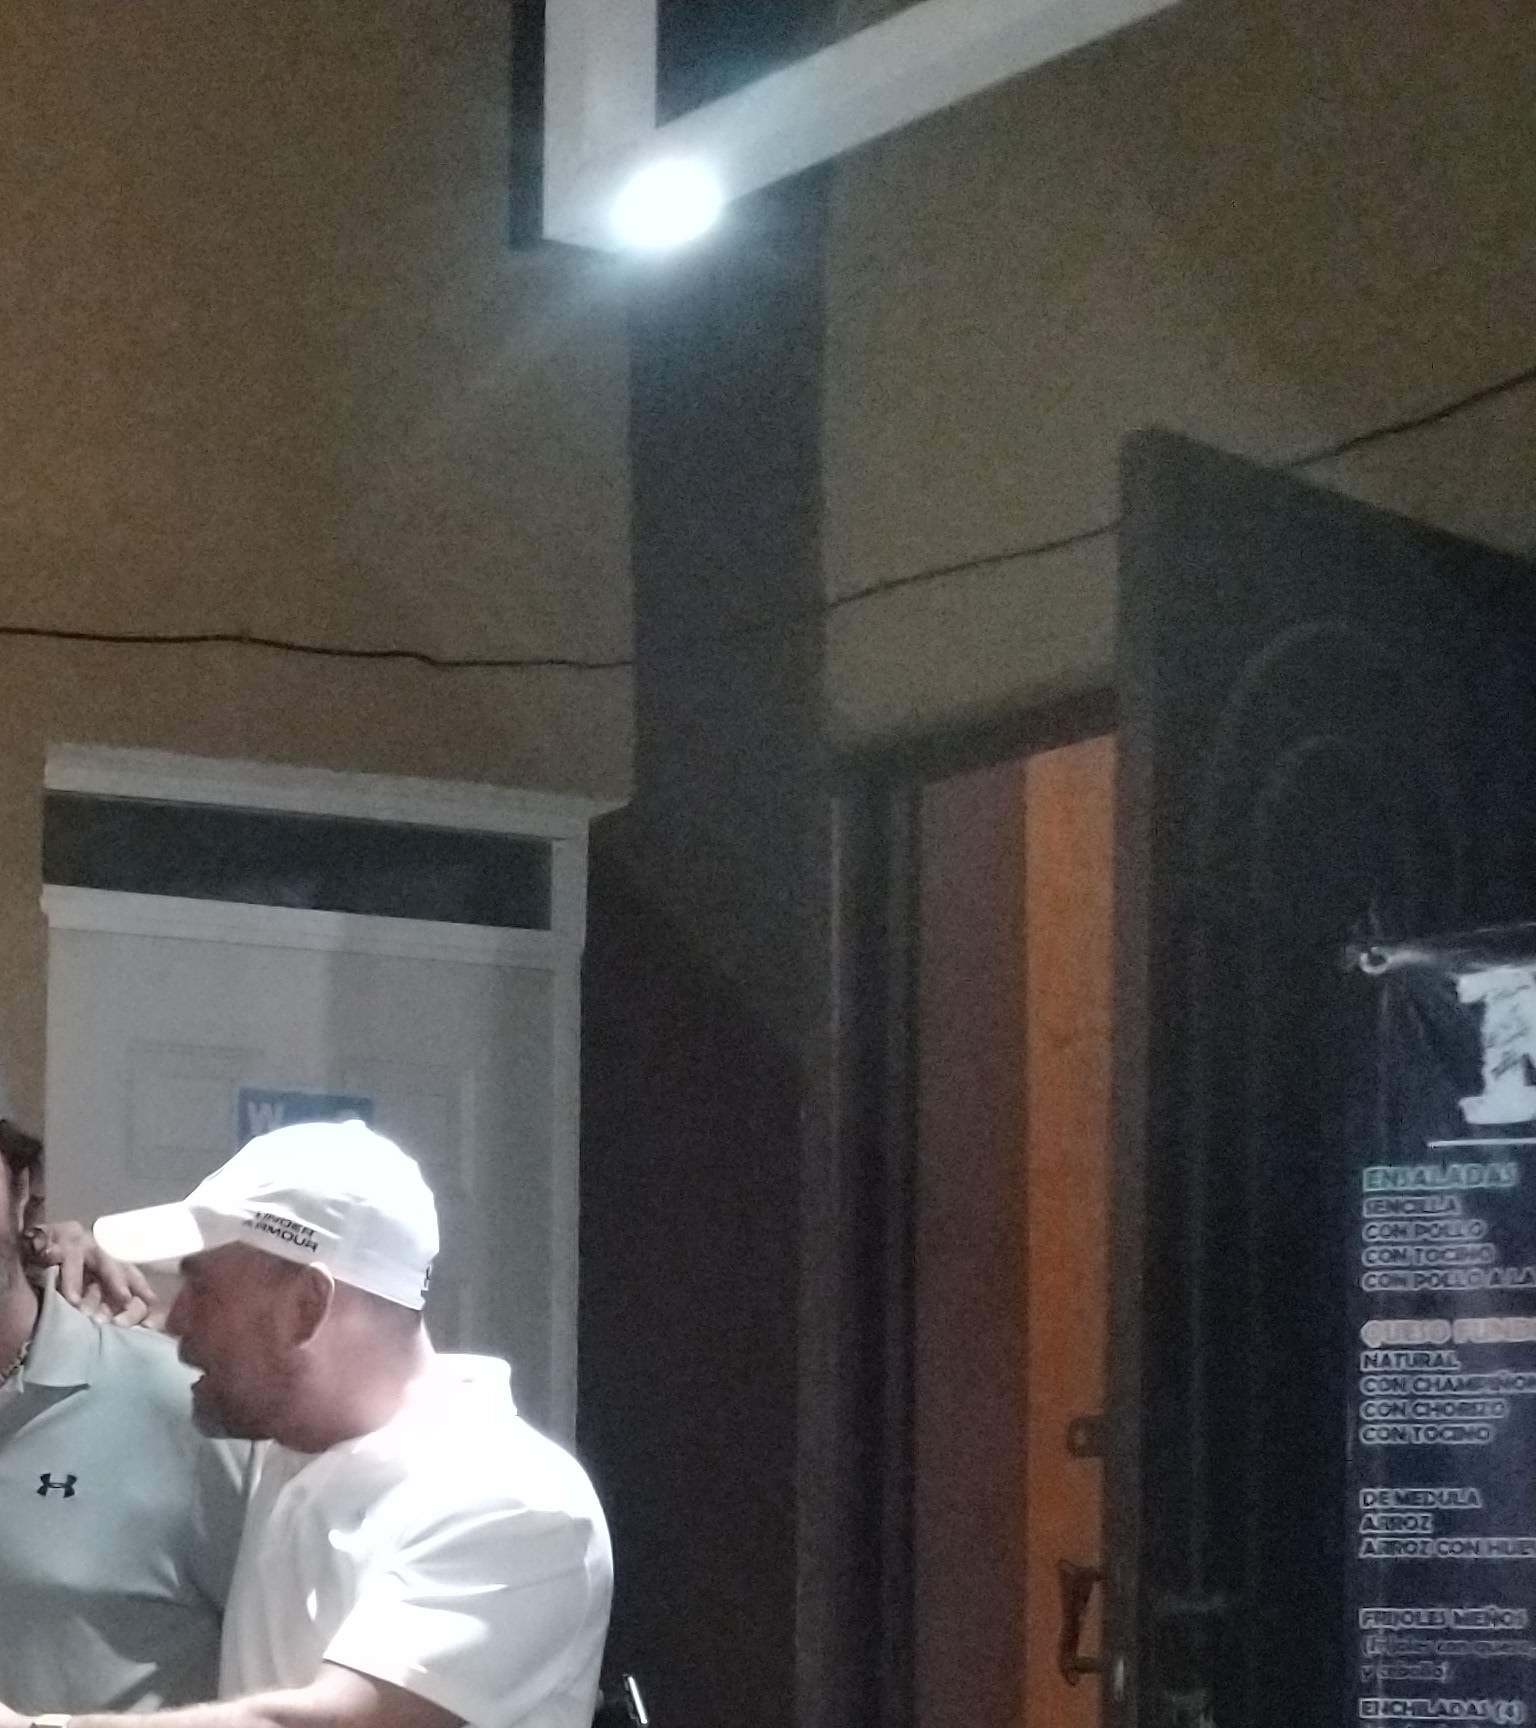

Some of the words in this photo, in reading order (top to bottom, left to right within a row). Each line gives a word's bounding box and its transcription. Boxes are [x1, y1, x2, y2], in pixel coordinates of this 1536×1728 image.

[255, 1211, 316, 1237] UNDER
[242, 1219, 318, 1253] ARMOUR
[1360, 1351, 1461, 1371] NATURAL
[1360, 1376, 1409, 1395] CON
[1360, 1401, 1408, 1420] CON
[1360, 1425, 1409, 1444] CON
[1411, 1424, 1493, 1443] TOCINO
